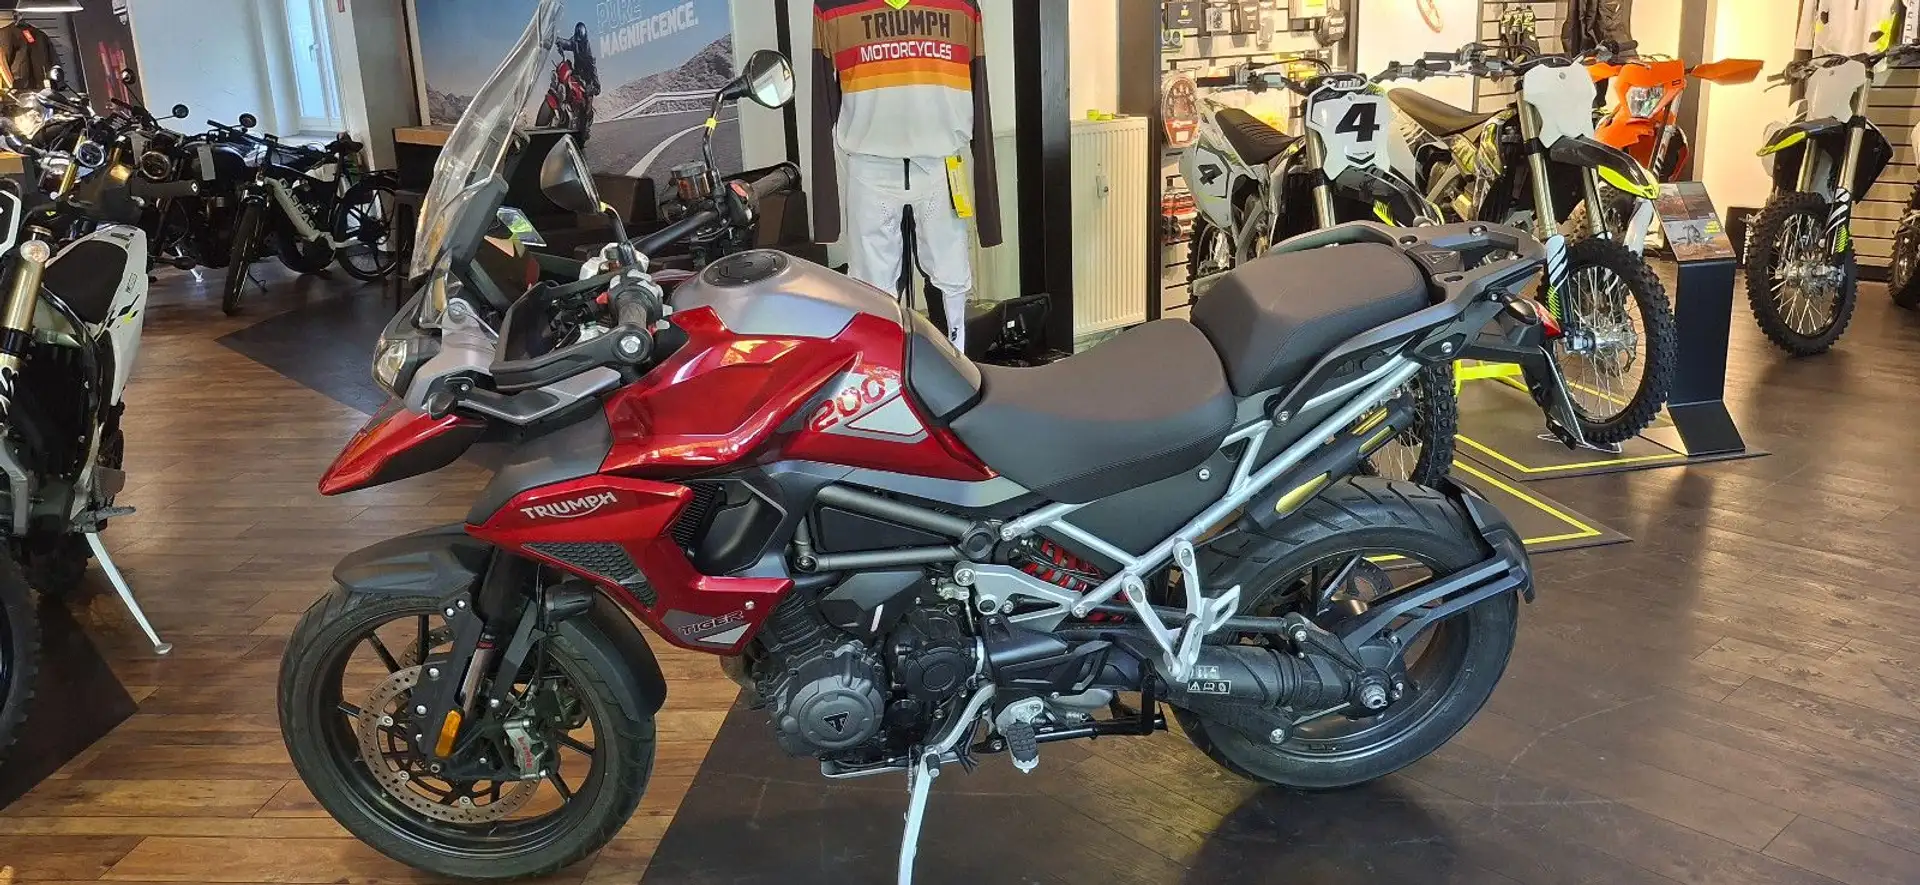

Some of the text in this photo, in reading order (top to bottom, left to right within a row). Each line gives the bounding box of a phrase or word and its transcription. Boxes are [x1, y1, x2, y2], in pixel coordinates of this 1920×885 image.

[600, 1, 699, 58] MAGNIFICENCE.
[860, 10, 951, 40] TRIUMPH
[860, 40, 952, 62] MOTORCYCLES
[1335, 102, 1380, 143] 4
[1197, 163, 1223, 186] 4
[278, 177, 316, 230] GASGAS
[520, 491, 617, 520] TRIUMPH
[678, 610, 744, 636] TIGER
